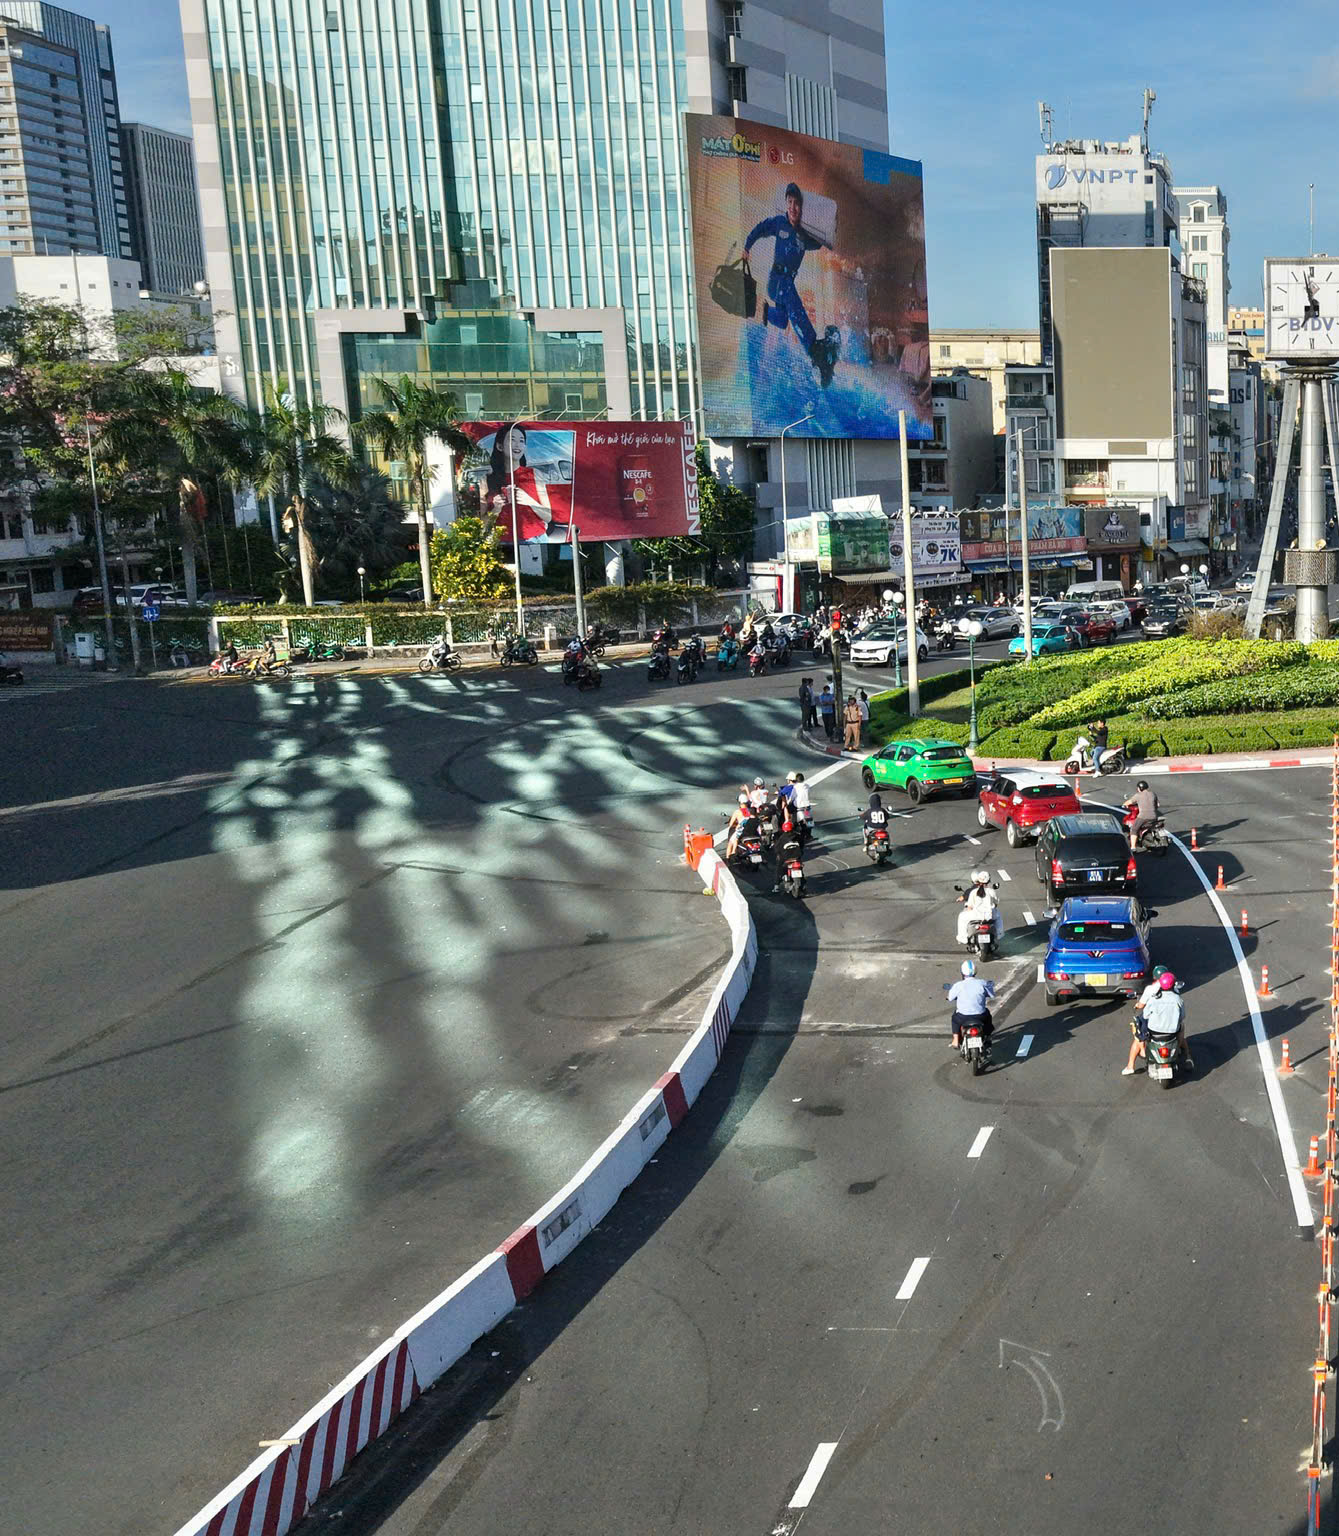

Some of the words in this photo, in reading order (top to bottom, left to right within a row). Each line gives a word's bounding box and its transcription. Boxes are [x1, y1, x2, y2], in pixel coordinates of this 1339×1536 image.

[781, 152, 794, 164] LG
[1071, 168, 1138, 183] VNPT
[1290, 317, 1334, 331] BIDV
[941, 548, 957, 562] 7K
[871, 811, 884, 823] 90
